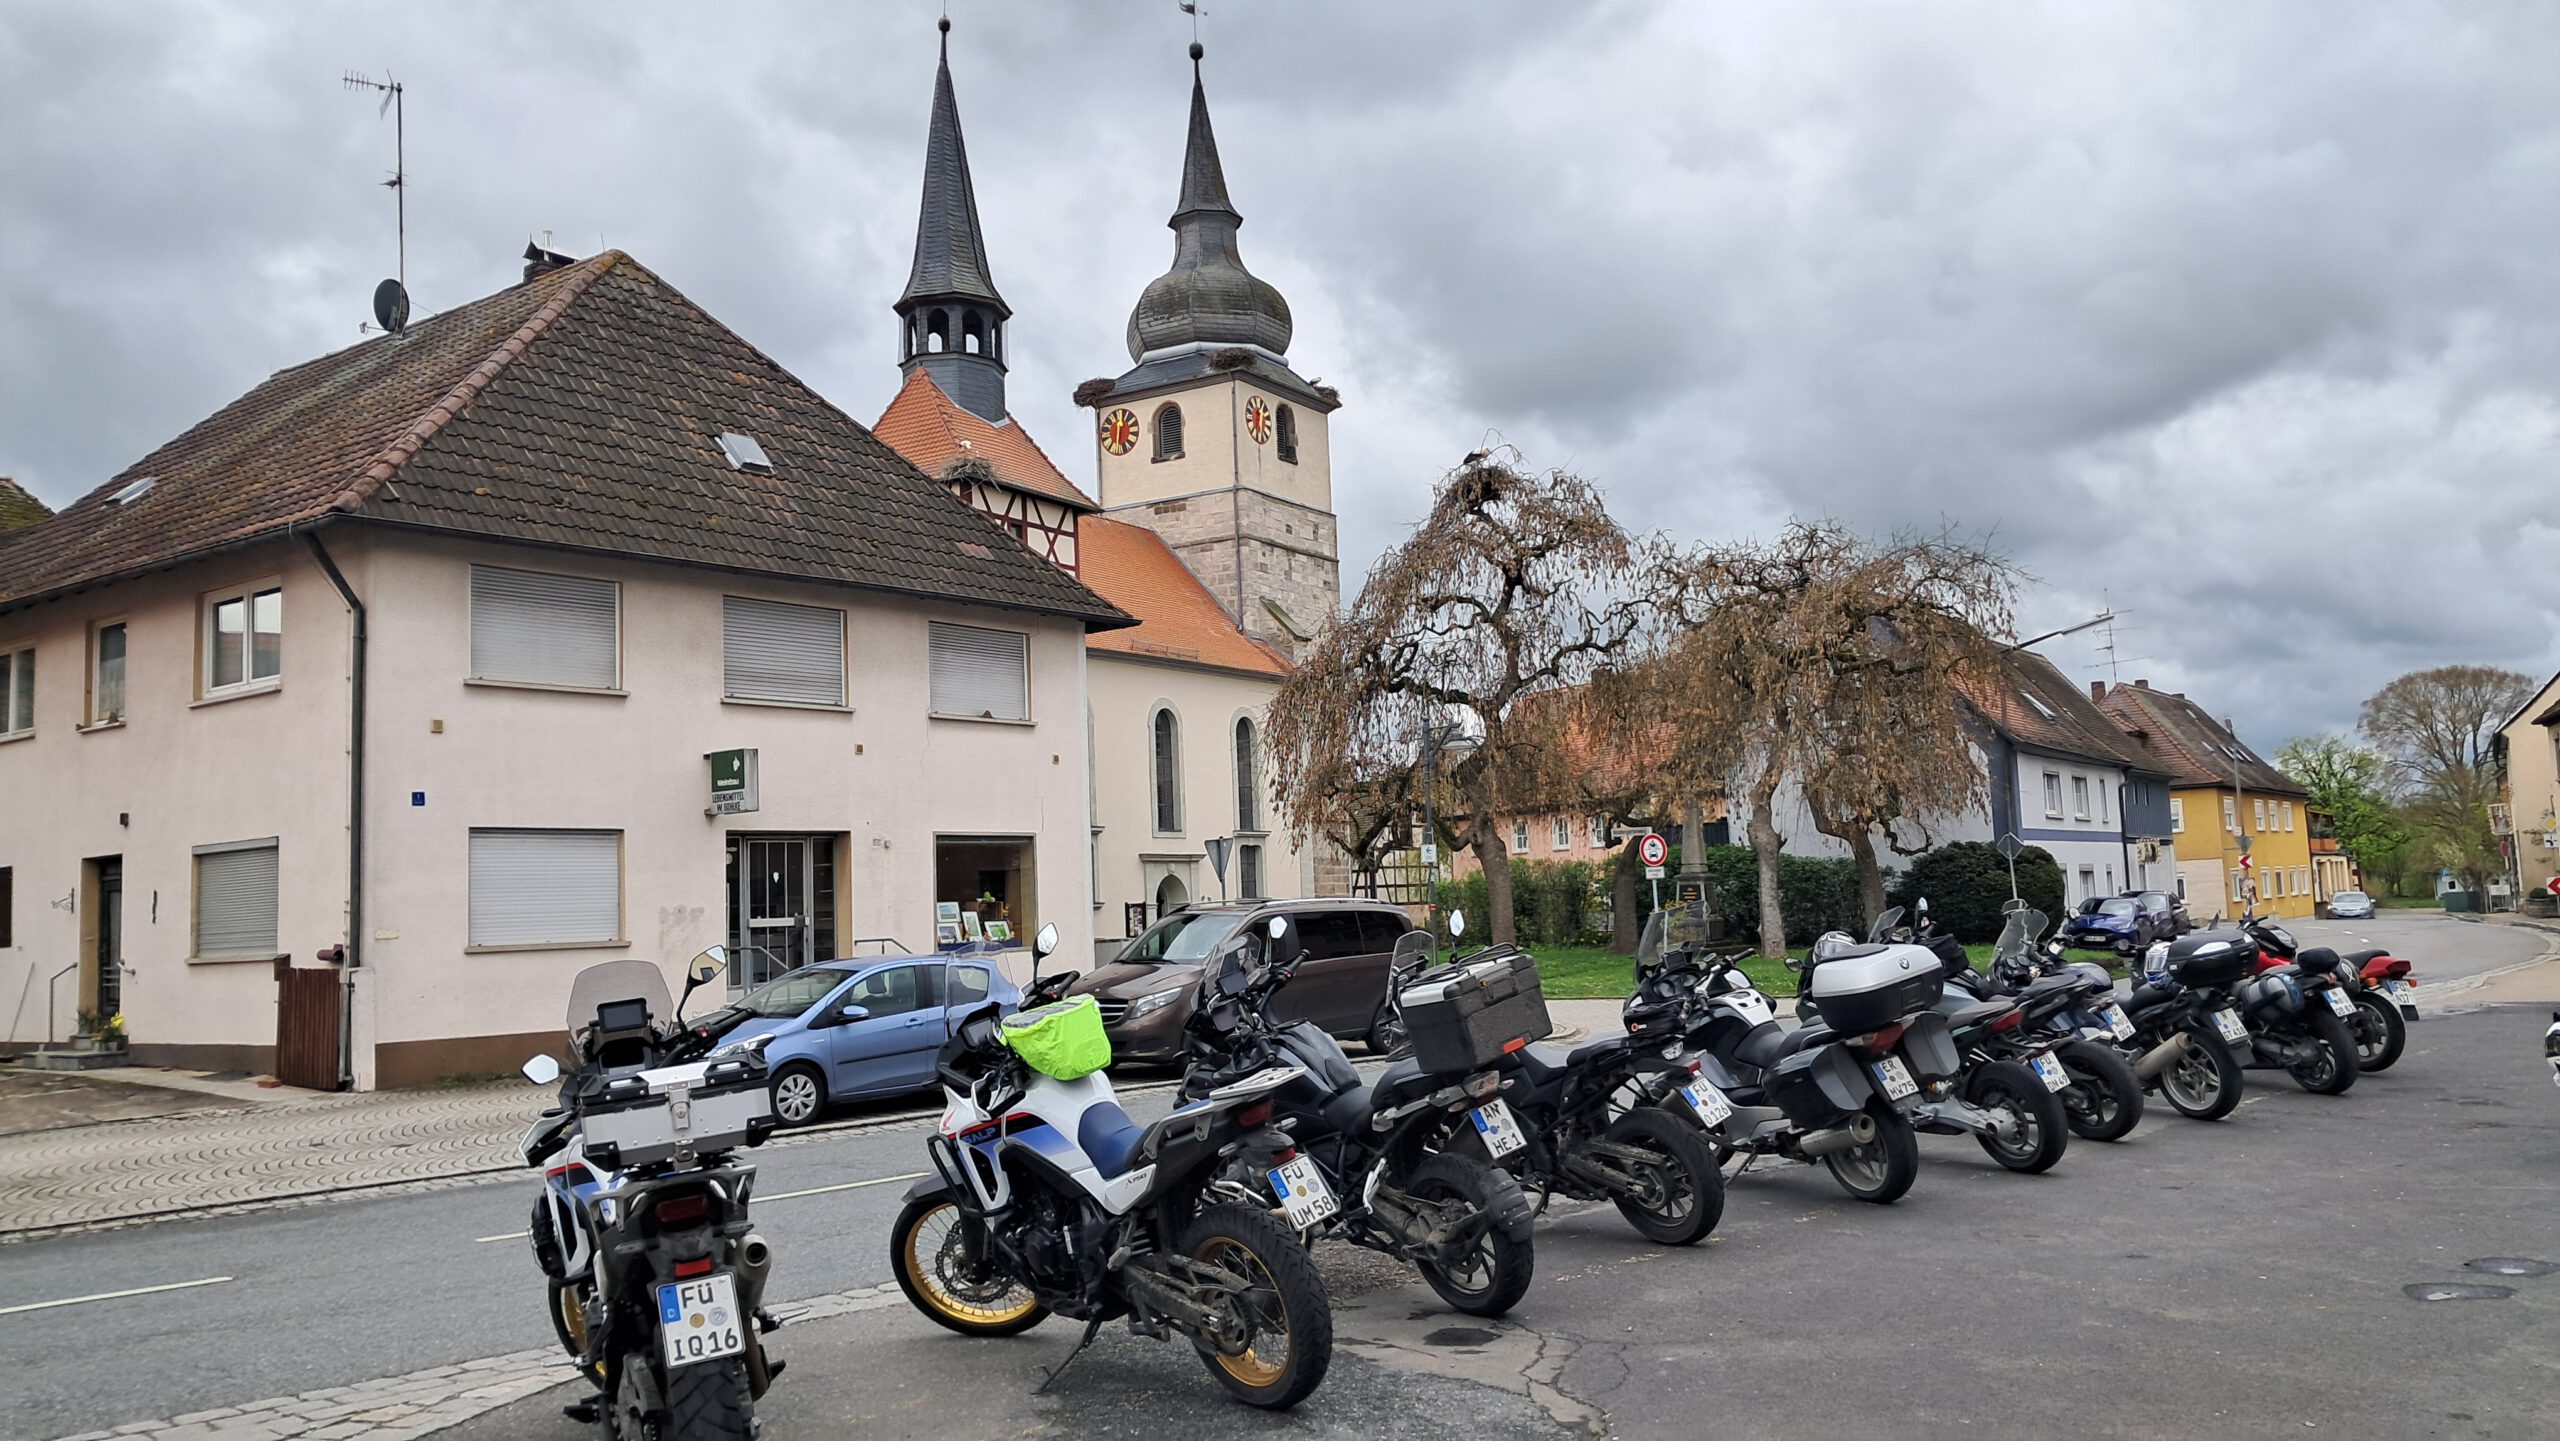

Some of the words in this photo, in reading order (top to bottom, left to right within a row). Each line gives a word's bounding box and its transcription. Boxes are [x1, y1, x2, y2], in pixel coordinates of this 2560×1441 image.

[1881, 1060, 1897, 1073] ER
[1483, 1102, 1501, 1121] AN
[1281, 1162, 1305, 1185] FÜ
[681, 1282, 714, 1309] FÜ
